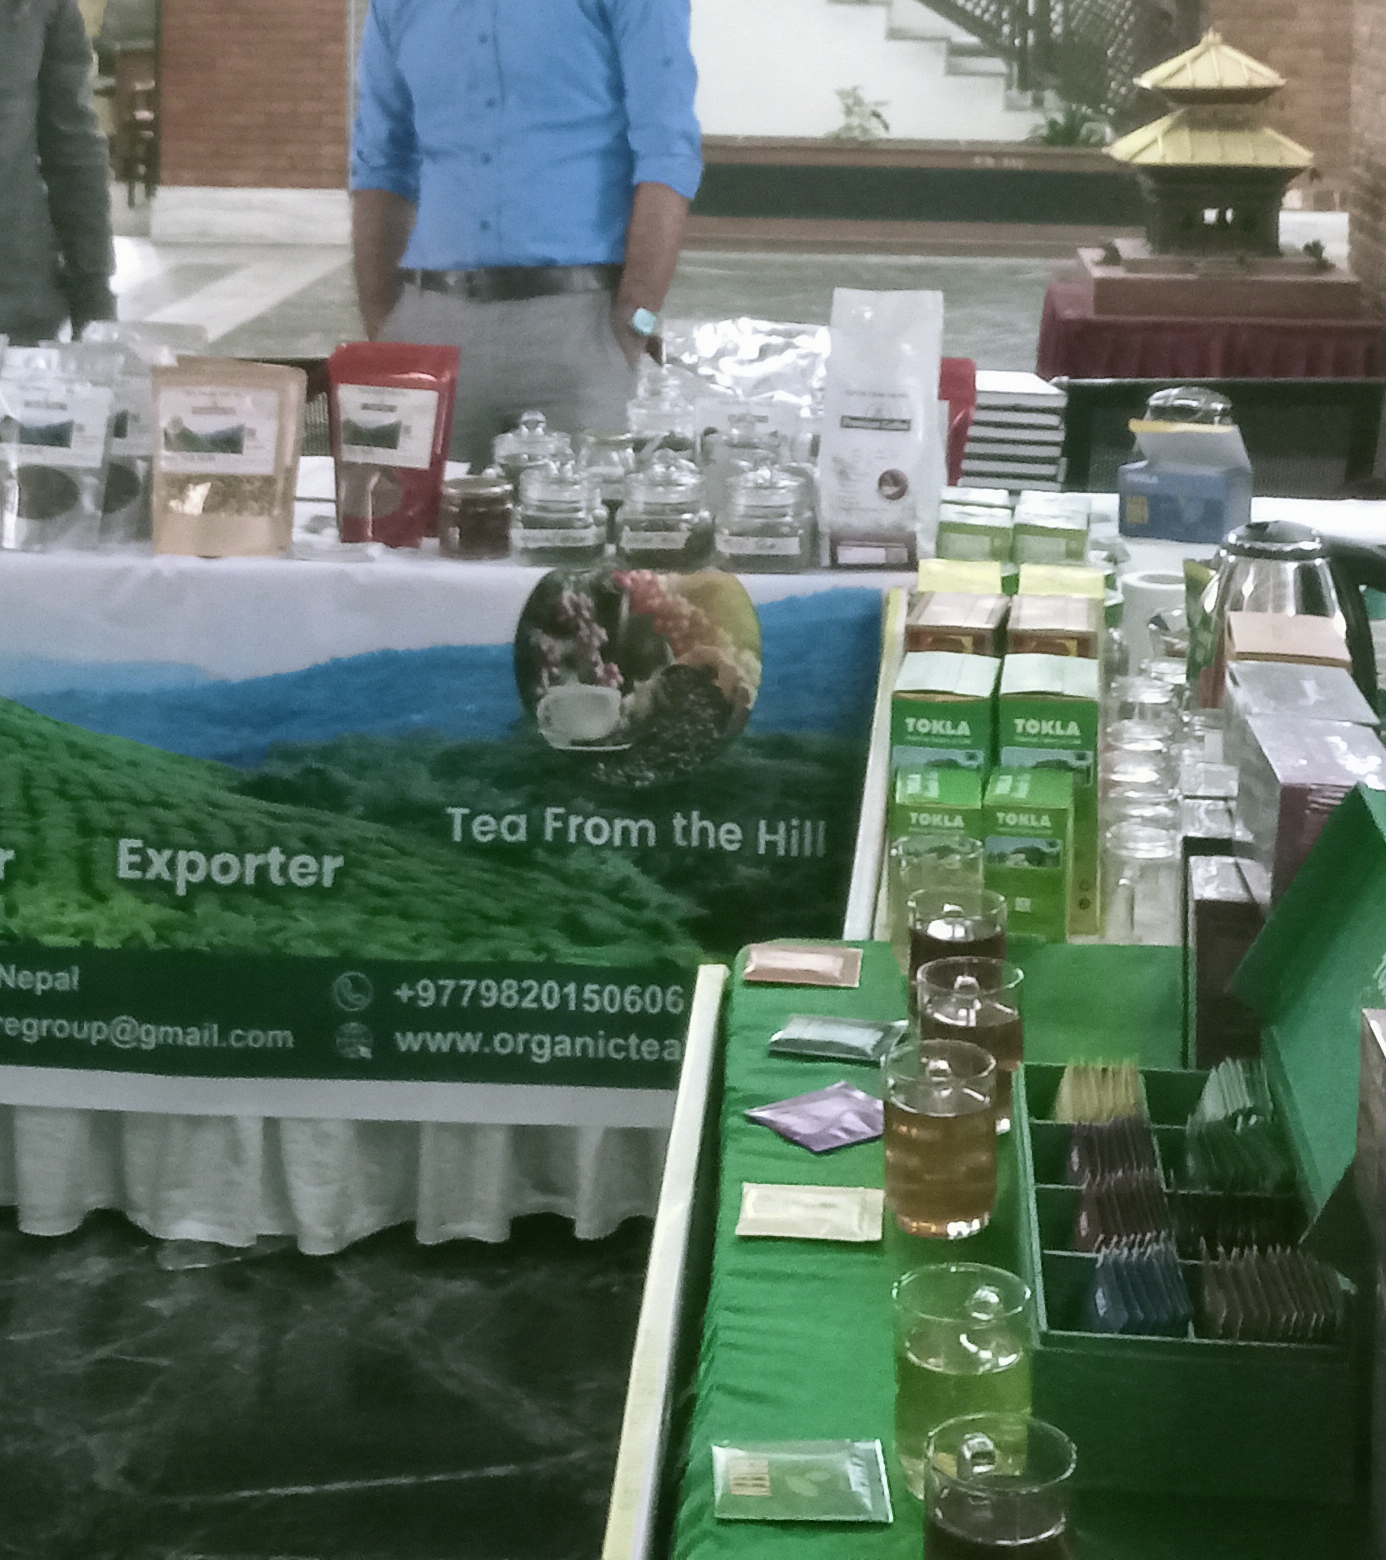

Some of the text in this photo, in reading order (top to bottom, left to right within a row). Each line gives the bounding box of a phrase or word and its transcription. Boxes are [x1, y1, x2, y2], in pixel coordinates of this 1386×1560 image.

[905, 717, 971, 736] TOKLA
[1014, 719, 1081, 736] TOKLA
[445, 807, 826, 858] Tea From the Hill
[910, 812, 965, 828] TOKLA
[996, 812, 1051, 827] TOKLA
[117, 839, 345, 896] Exporter
[394, 978, 685, 1014] +9779820150606
[394, 1030, 686, 1064] www.organictea
